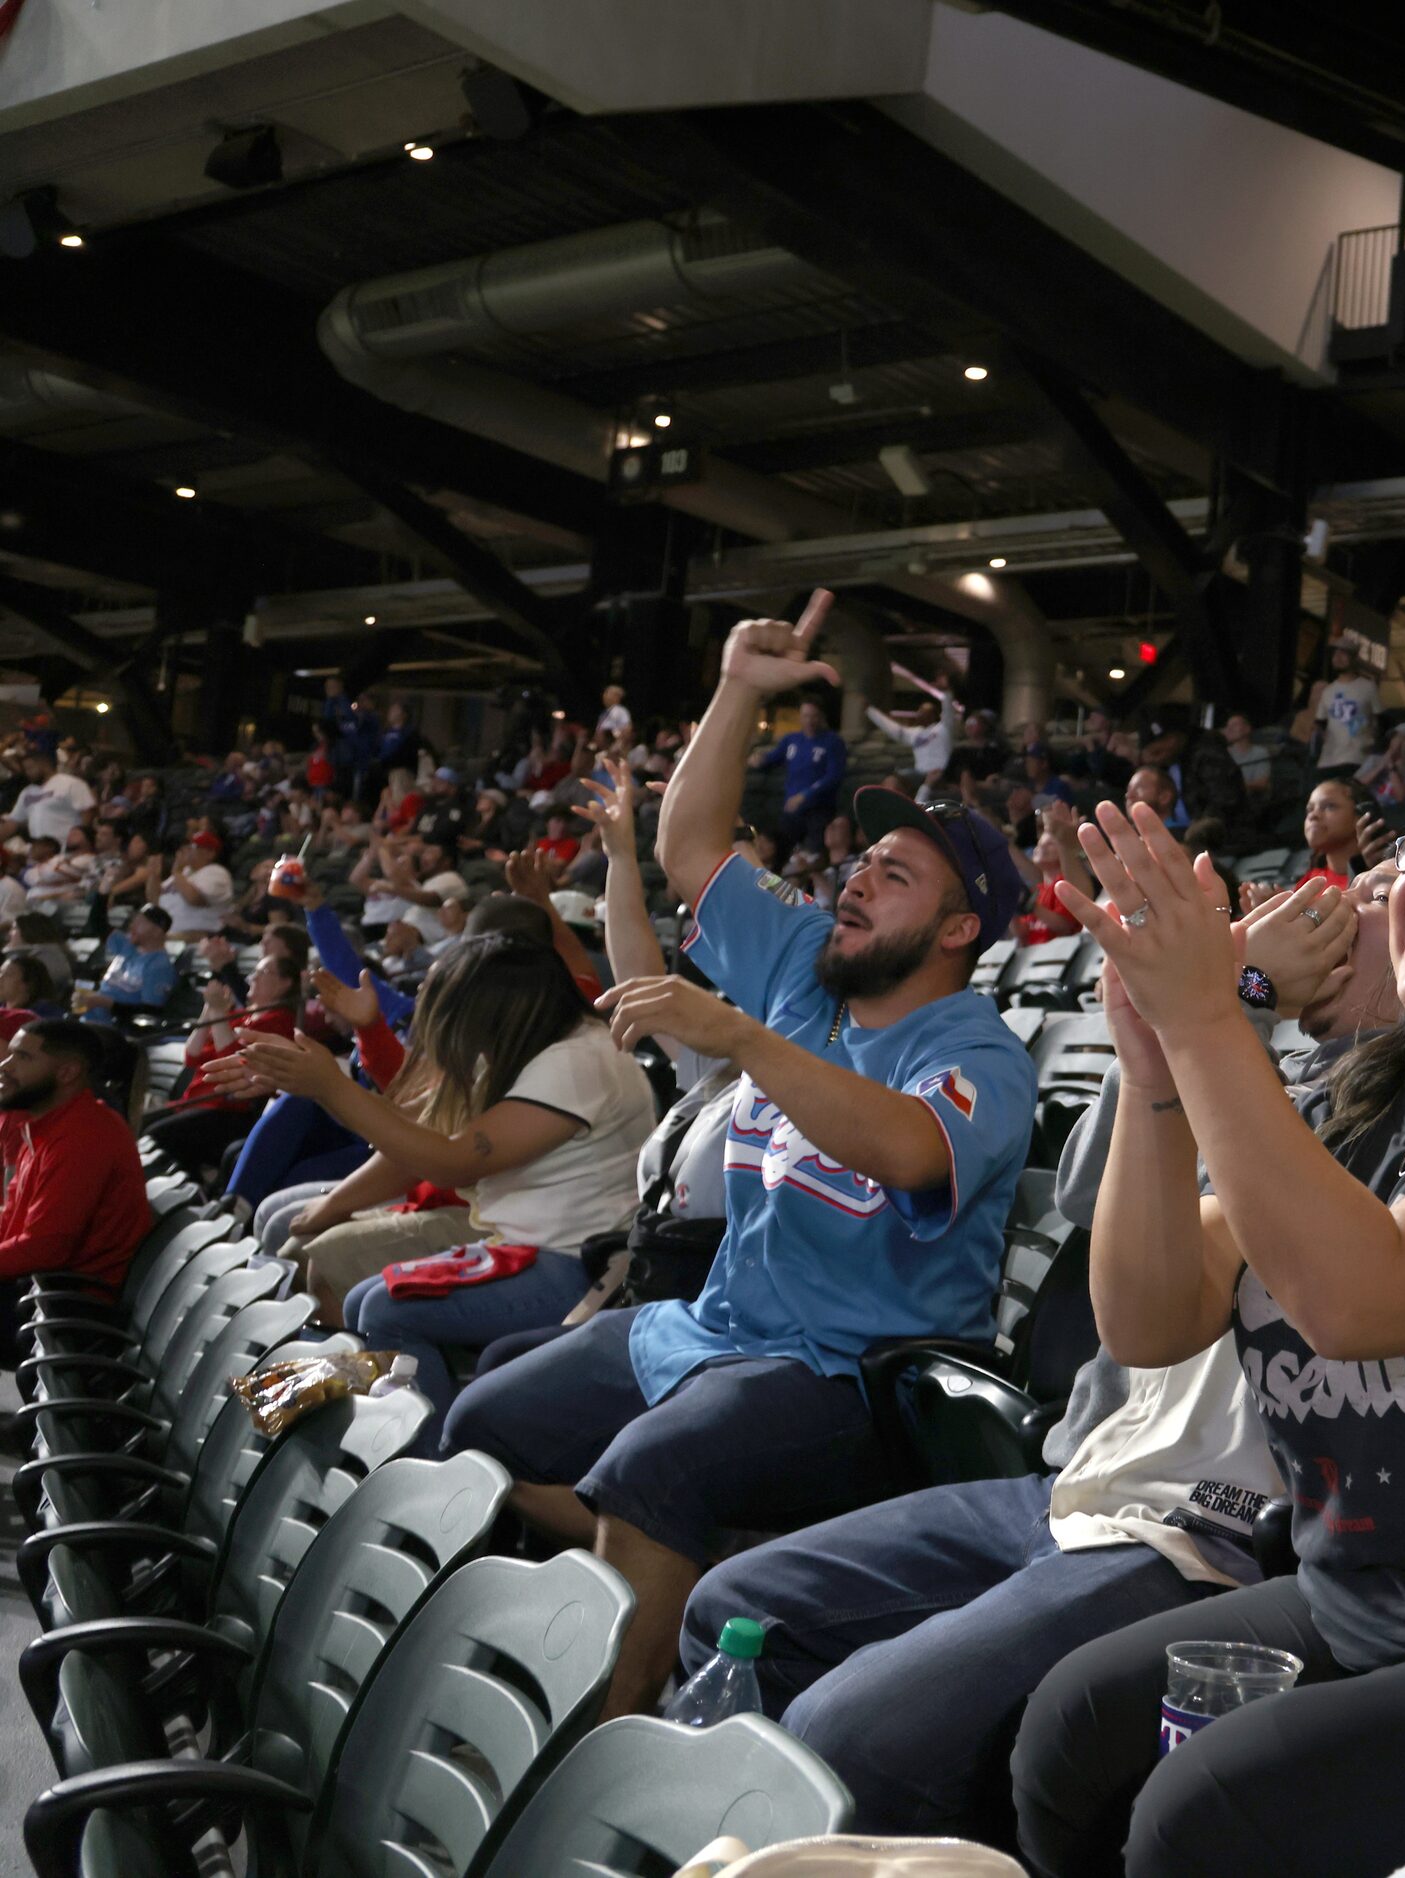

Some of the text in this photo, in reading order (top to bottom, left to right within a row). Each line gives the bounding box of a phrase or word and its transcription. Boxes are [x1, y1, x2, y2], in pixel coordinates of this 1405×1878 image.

[1189, 1490, 1213, 1508] BIG
[1211, 1497, 1259, 1525] DREAM
[1195, 1479, 1268, 1510] DREAM THE
